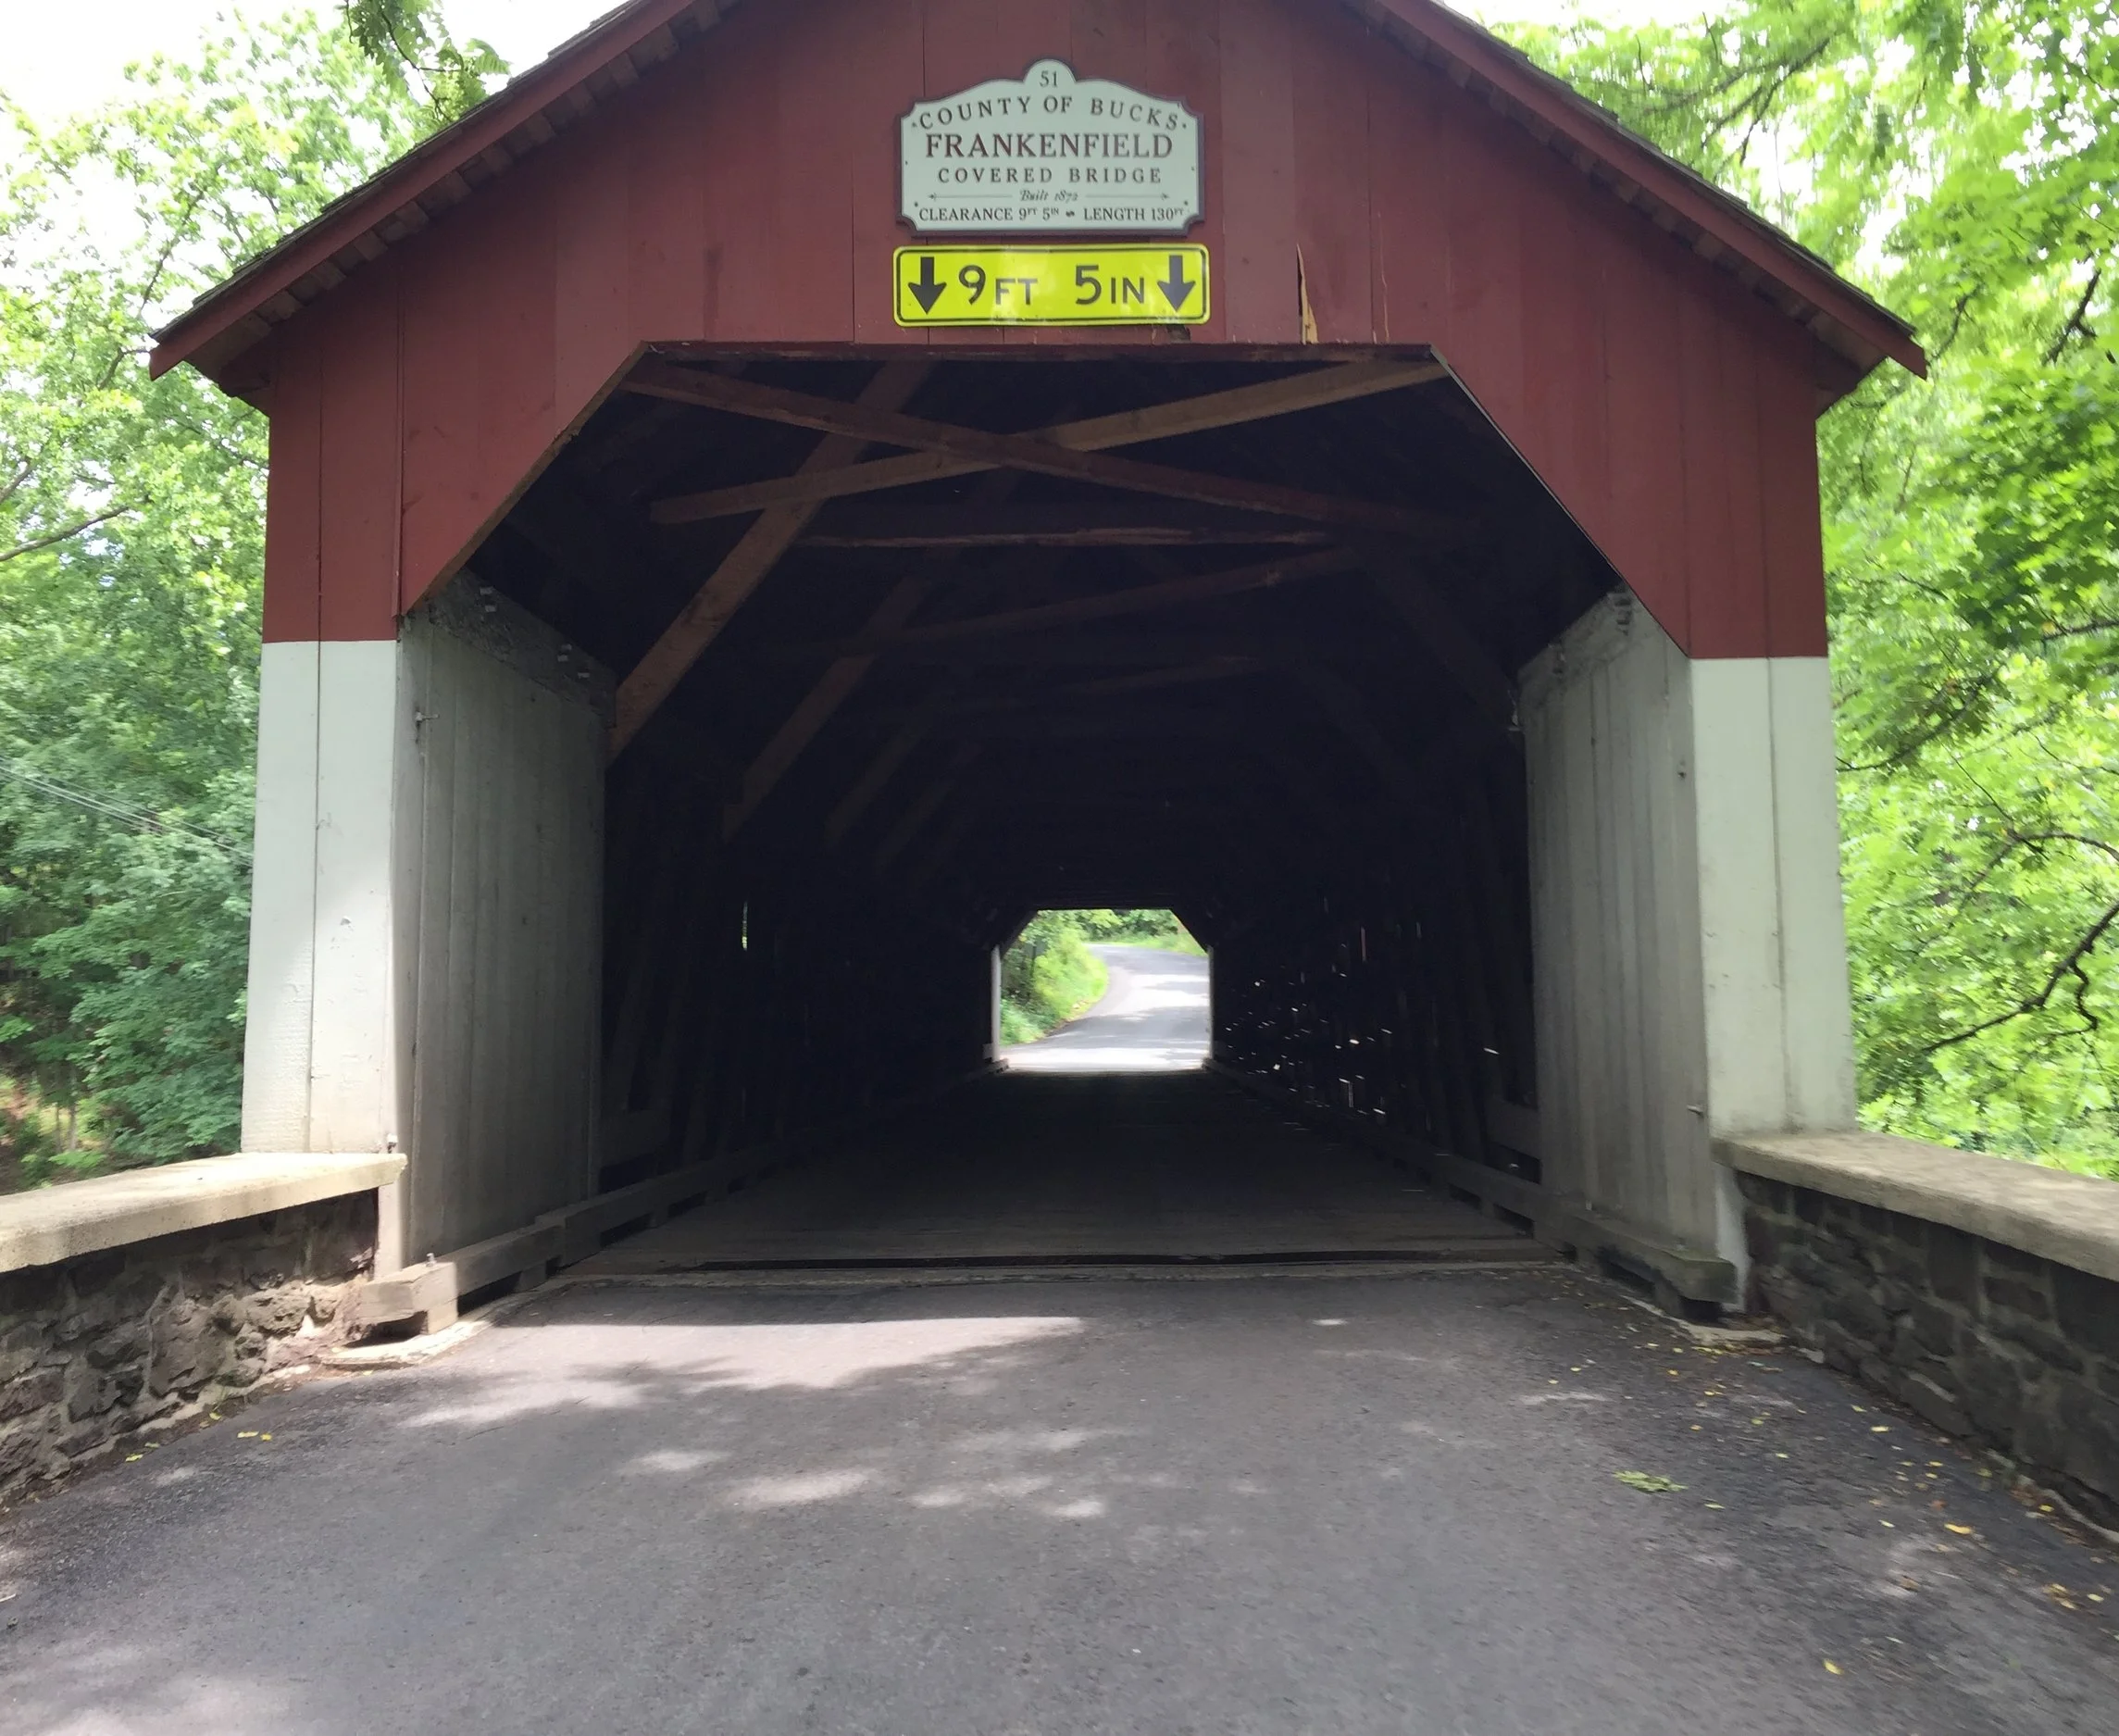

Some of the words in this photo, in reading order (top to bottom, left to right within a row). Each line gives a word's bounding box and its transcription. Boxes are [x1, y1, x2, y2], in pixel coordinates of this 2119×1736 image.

[1040, 70, 1058, 87] 51
[919, 96, 1031, 130] COUNTY
[1044, 96, 1072, 113] OF
[1090, 98, 1178, 130] BUCKS
[926, 133, 1173, 158] FRANKENFIELD
[938, 168, 1053, 183] COVERED
[1069, 169, 1162, 183] BRIDGE
[1020, 190, 1049, 201] Built
[1054, 191, 1078, 202] 1872
[919, 207, 1013, 221] CLEARANCE
[1084, 207, 1145, 221] LENGTH
